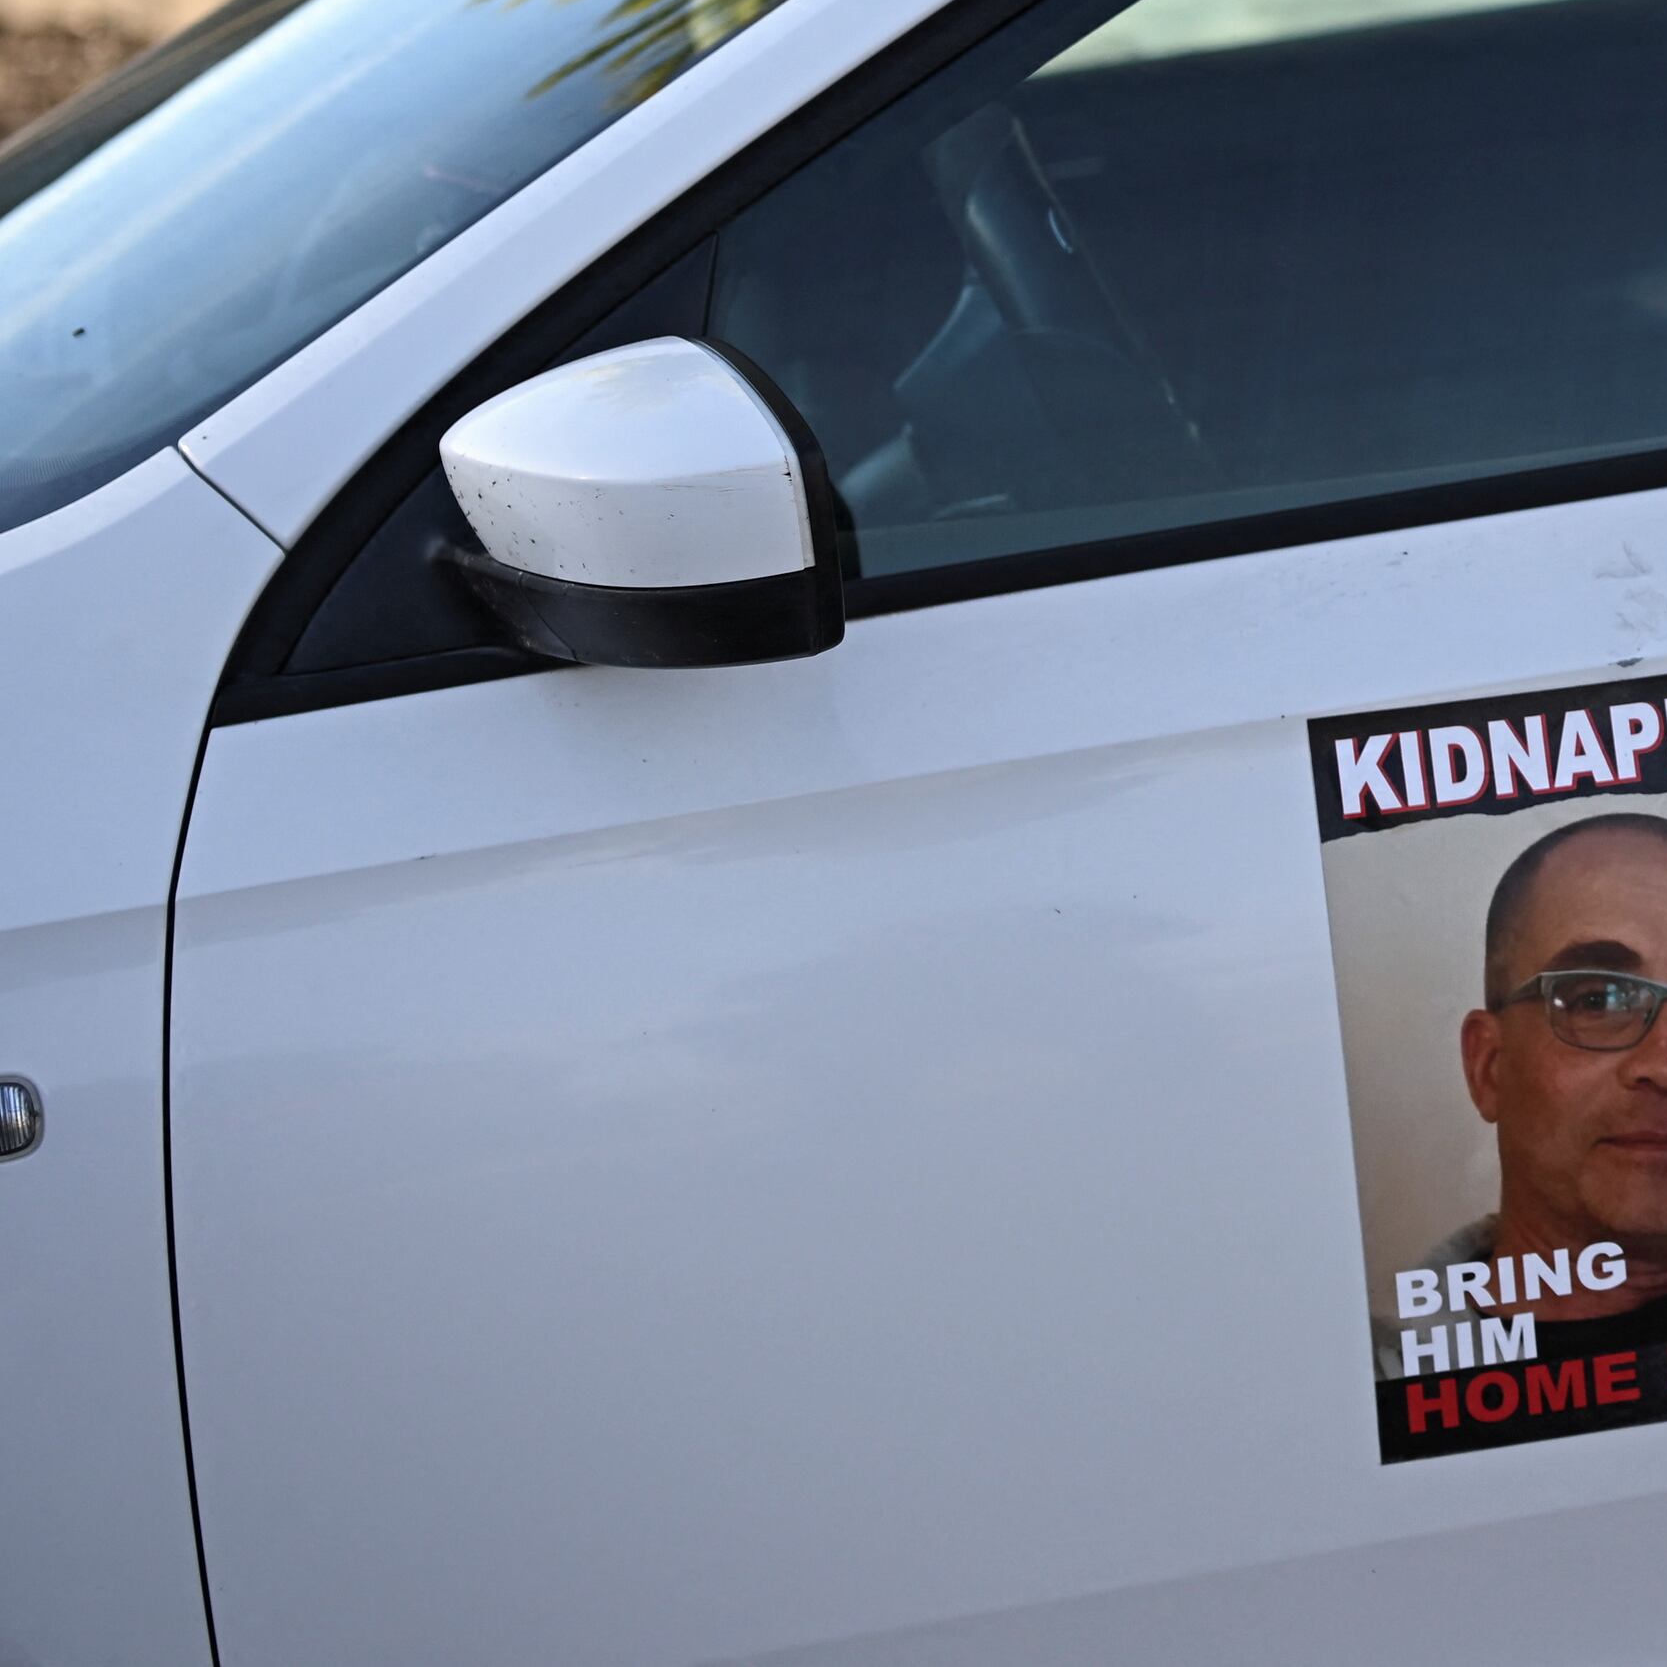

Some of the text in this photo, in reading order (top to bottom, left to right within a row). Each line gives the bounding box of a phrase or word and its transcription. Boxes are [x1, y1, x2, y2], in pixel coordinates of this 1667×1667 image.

[1396, 1241, 1627, 1320] BRING
[1401, 1313, 1538, 1377] HIM
[1406, 1351, 1641, 1434] HOME
